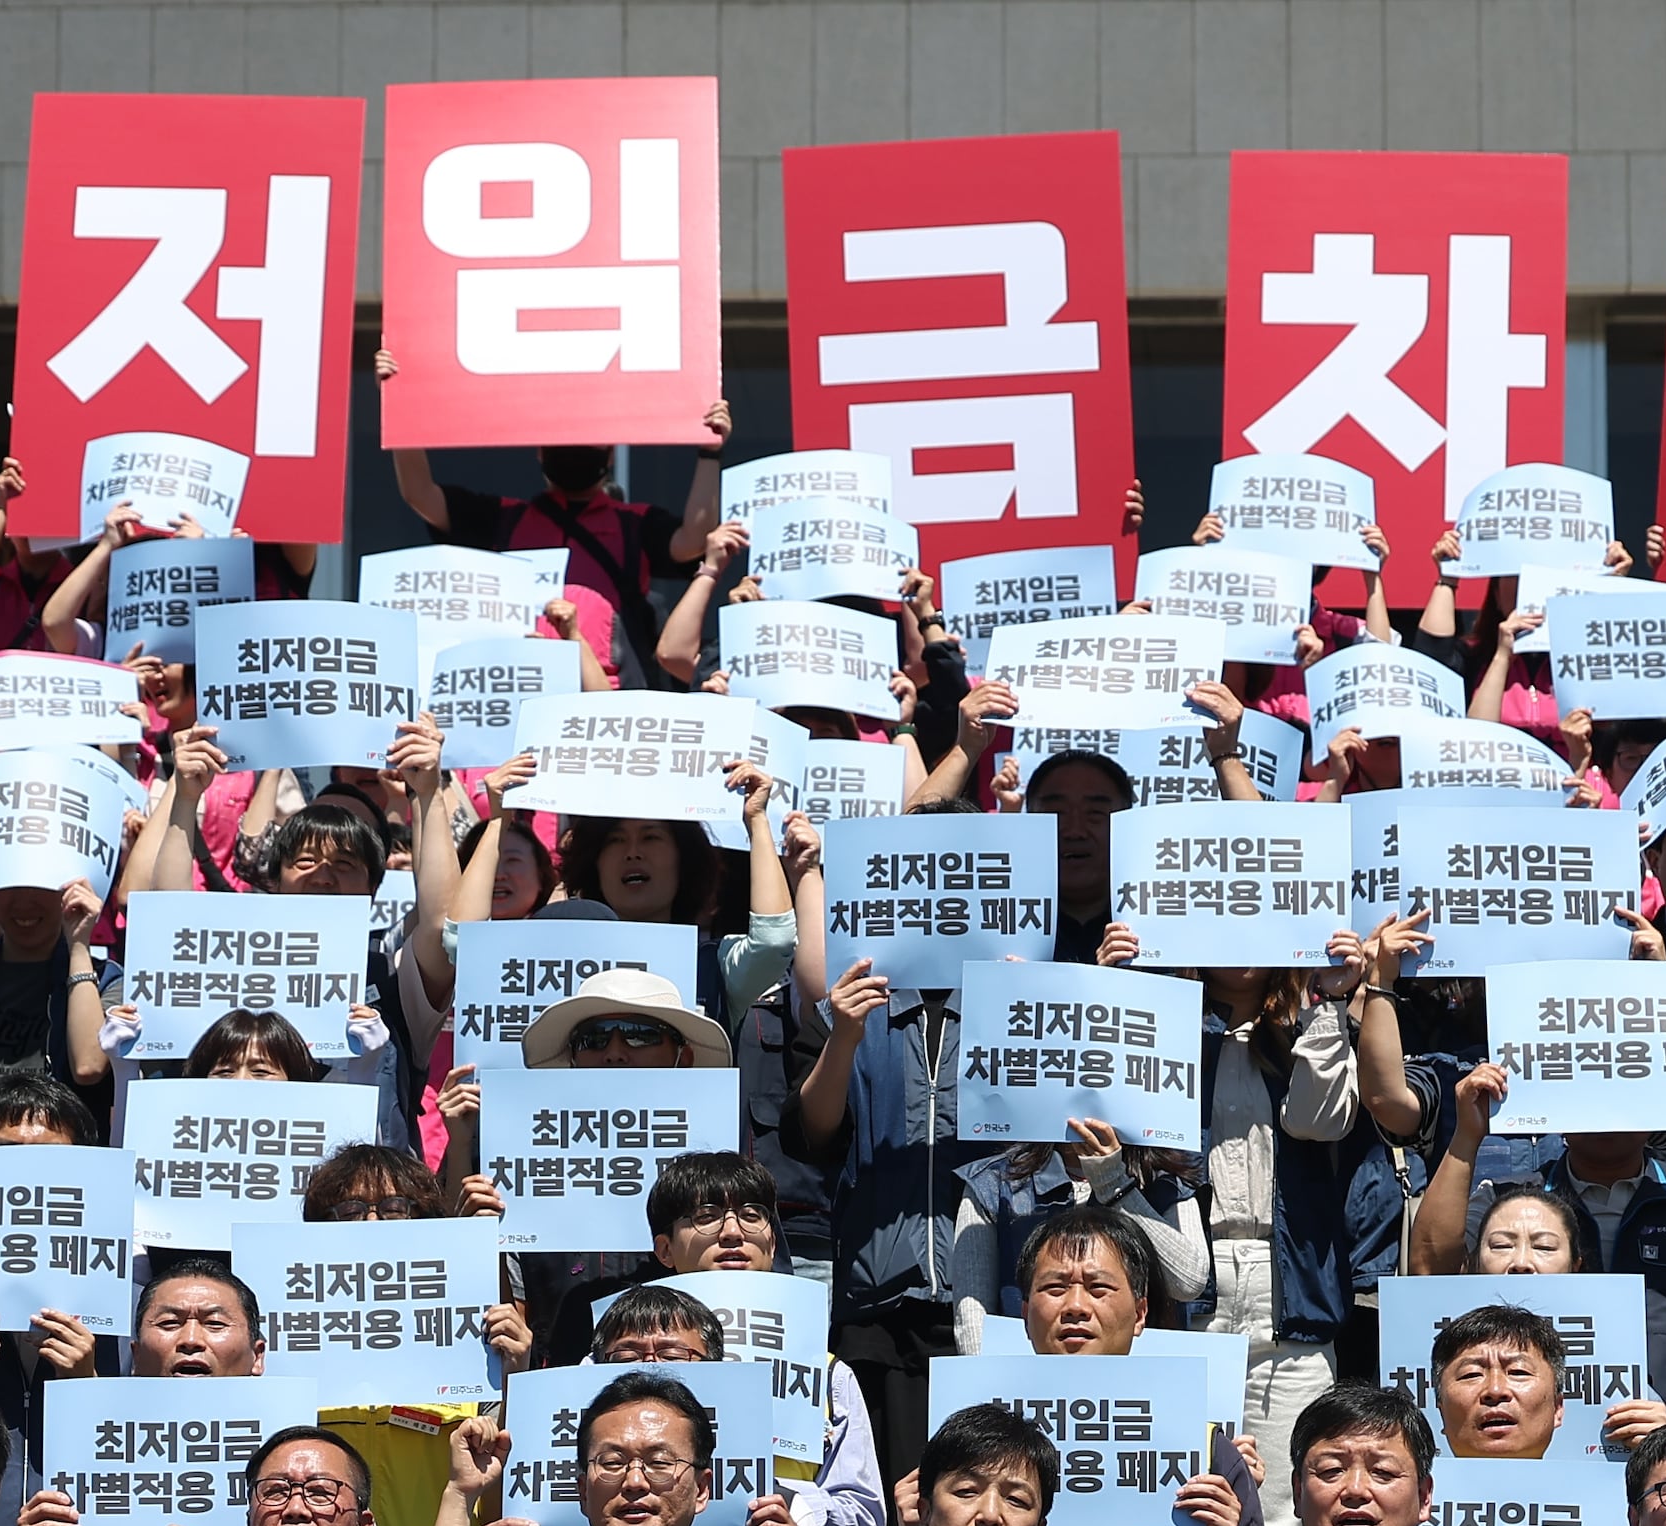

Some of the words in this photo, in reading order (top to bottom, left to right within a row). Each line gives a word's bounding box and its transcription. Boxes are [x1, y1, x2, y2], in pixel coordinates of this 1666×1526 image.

[423, 138, 680, 374] 임
[47, 176, 330, 458] 저
[819, 220, 1100, 521] 금
[1242, 232, 1547, 521] 차
[238, 637, 378, 675] 최저임금
[1557, 652, 1666, 681] 차별적용
[202, 679, 338, 721] 차별적용
[348, 682, 414, 723] 폐지
[866, 852, 1012, 891] 최저임금
[1156, 837, 1303, 873] 최저임금
[829, 898, 970, 938] 차별적용
[981, 897, 1052, 936] 폐지
[1116, 880, 1262, 916] 차별적용
[1272, 880, 1345, 915] 폐지
[173, 928, 320, 966] 최저임금
[130, 970, 276, 1009] 차별적용
[286, 973, 359, 1008] 폐지
[1008, 1000, 1156, 1048] 최저임금
[965, 1046, 1114, 1088] 차별적용
[1125, 1054, 1195, 1099] 폐지
[1496, 1041, 1652, 1080] 차별적용
[49, 1235, 127, 1279] 폐지
